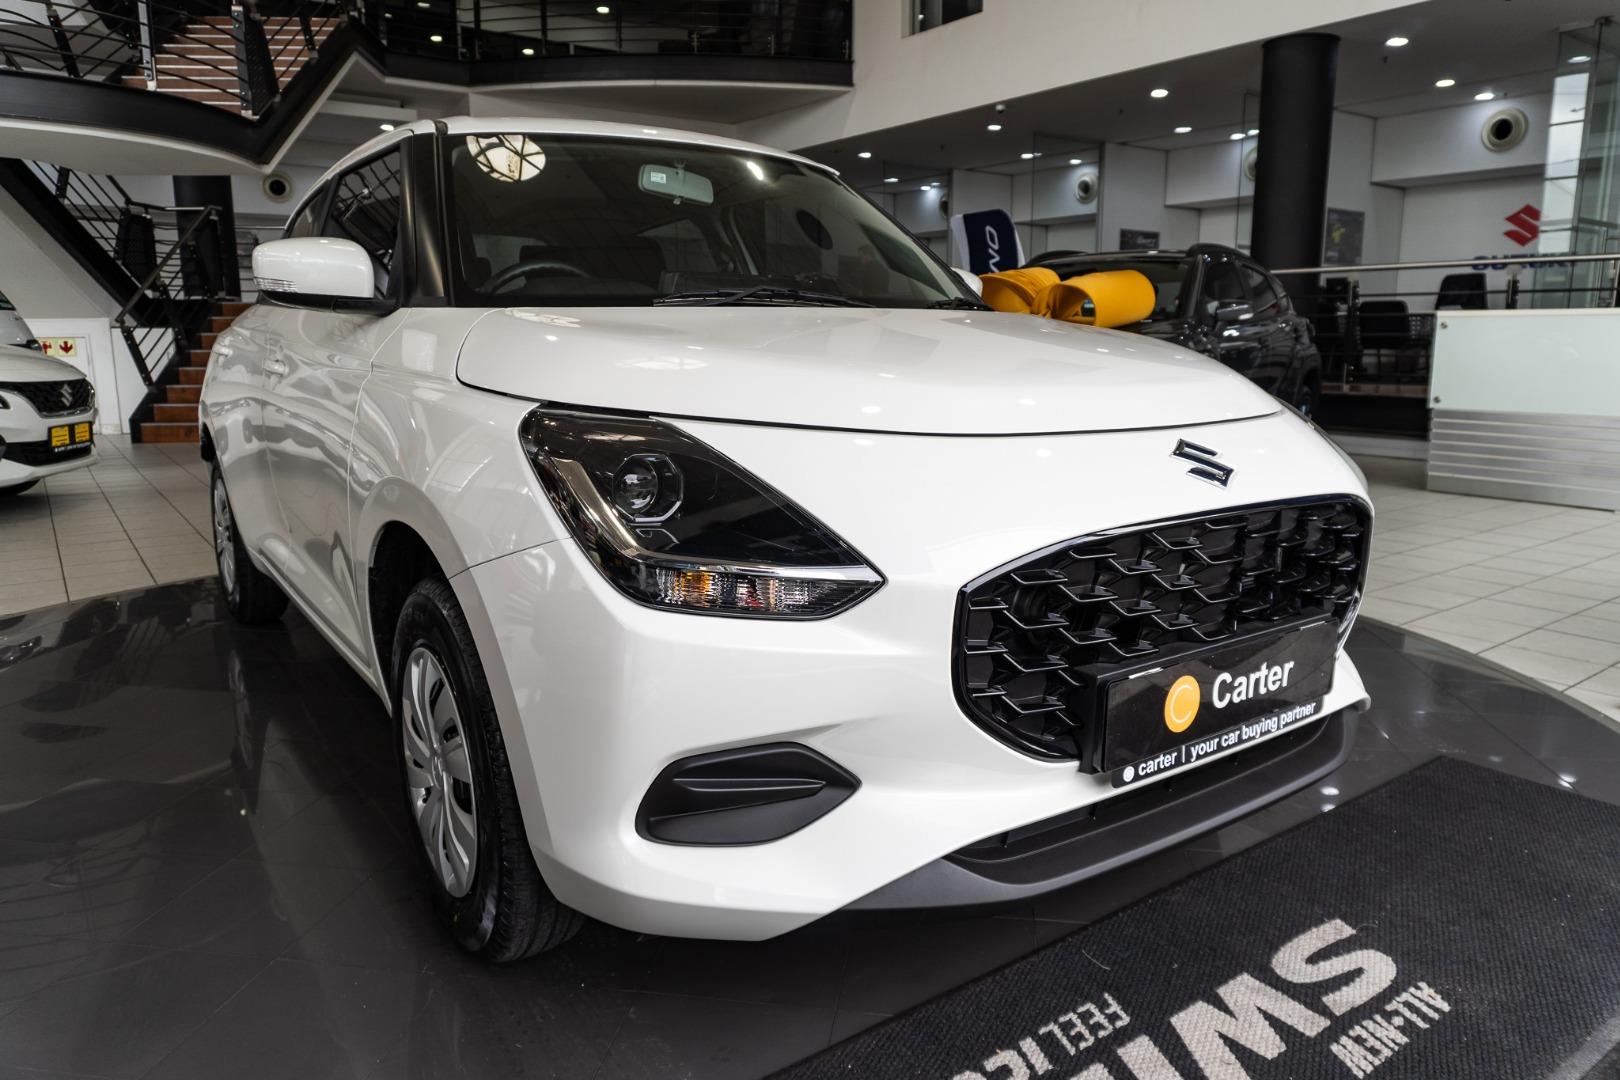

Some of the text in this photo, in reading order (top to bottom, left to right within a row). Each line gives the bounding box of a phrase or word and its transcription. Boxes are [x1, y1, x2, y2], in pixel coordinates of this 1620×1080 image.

[985, 225, 1000, 273] NO
[1213, 661, 1295, 709] Carter
[1138, 750, 1178, 777] carter
[1191, 738, 1219, 762] your
[1221, 729, 1241, 748] car
[1242, 715, 1279, 740] buying
[1280, 702, 1317, 729] partner
[952, 992, 1131, 1080] FEEL IC
[1070, 919, 1398, 1080] SWI
